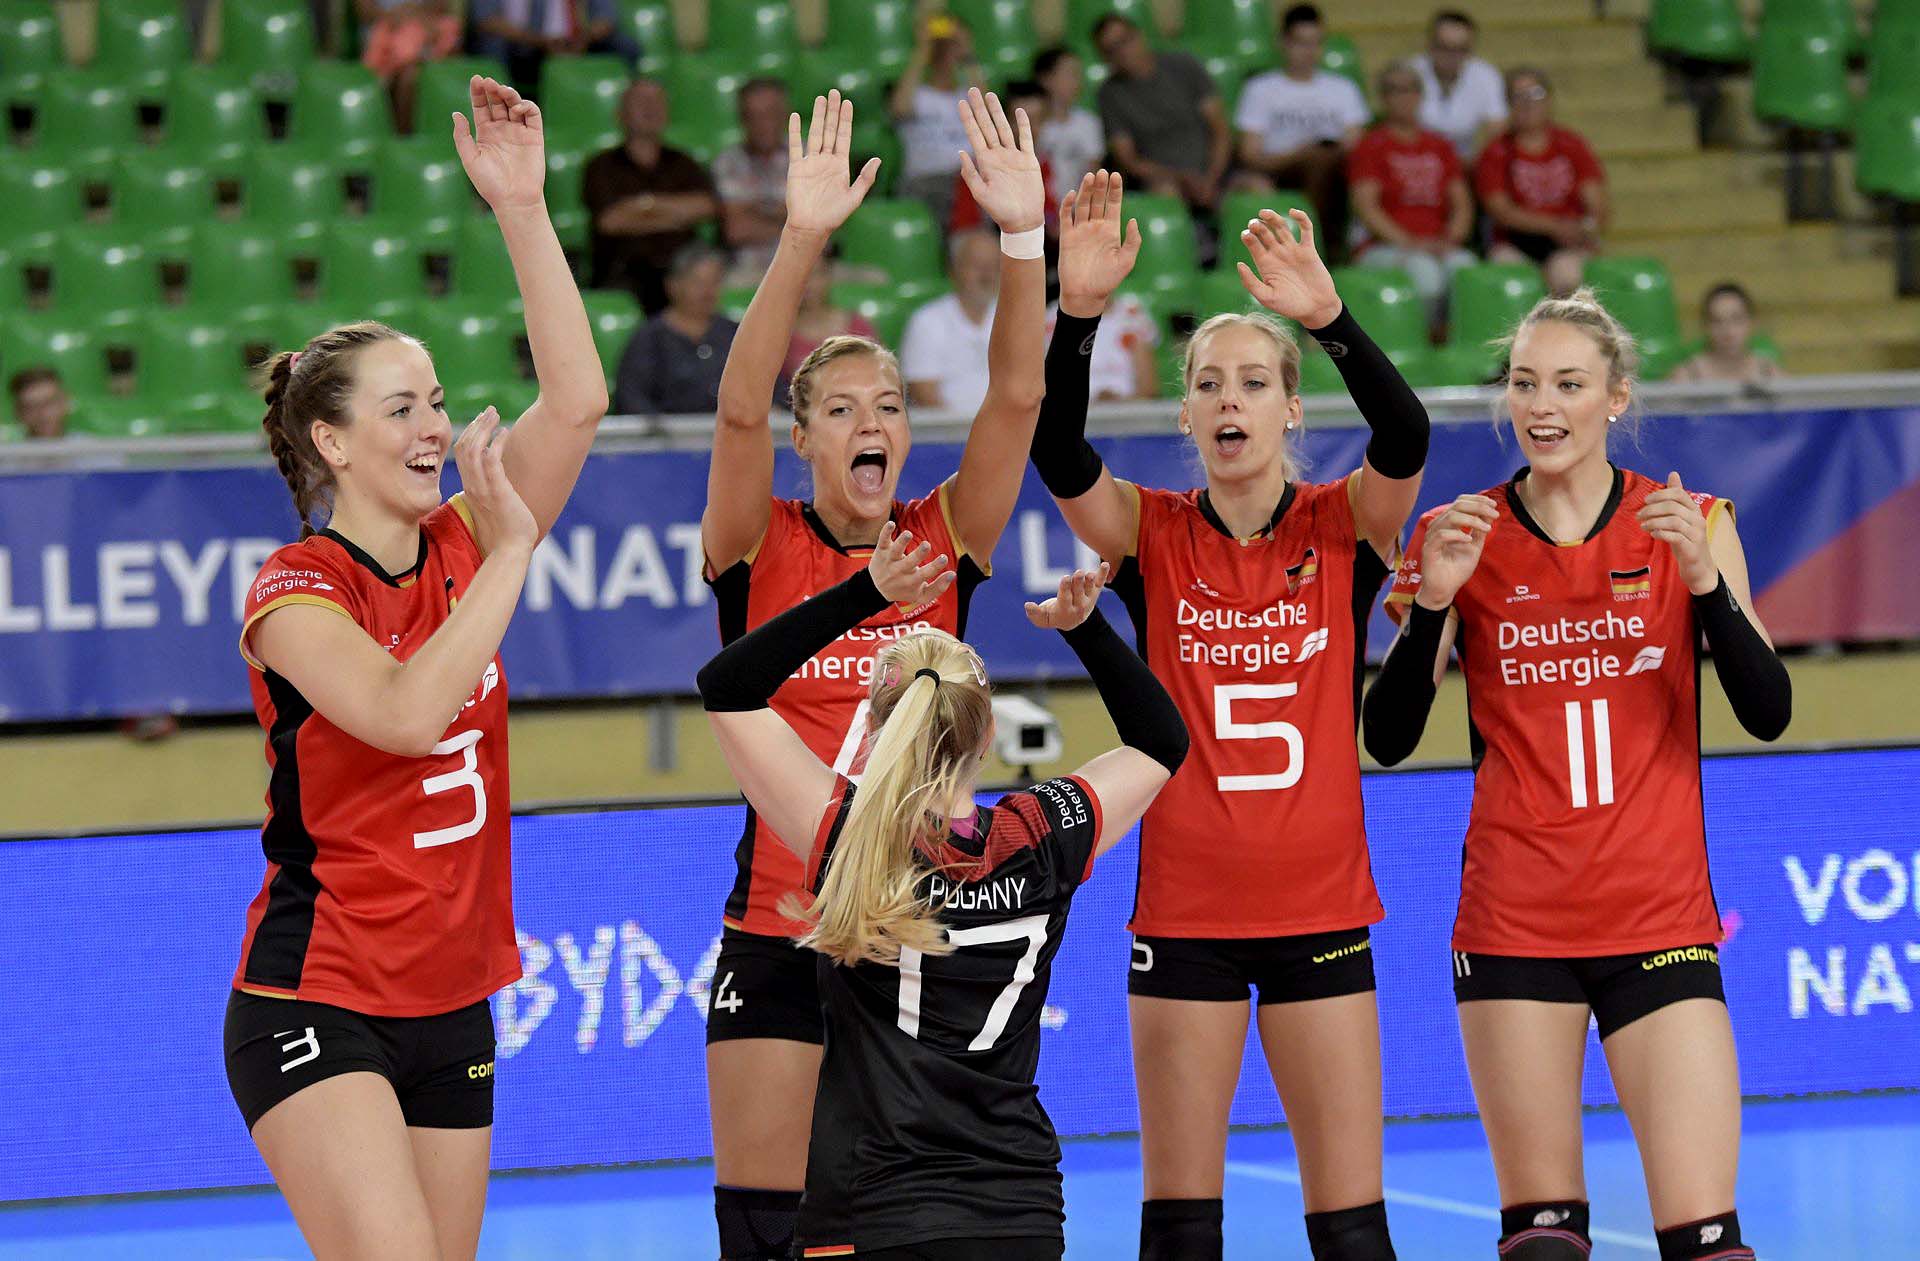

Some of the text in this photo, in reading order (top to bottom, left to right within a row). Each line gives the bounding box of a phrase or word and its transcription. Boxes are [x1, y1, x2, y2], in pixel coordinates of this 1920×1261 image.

[256, 569, 323, 591] Deutsche
[256, 577, 309, 603] Energie
[1177, 599, 1308, 631] Deutsche
[1499, 610, 1645, 650] Deutsche
[1178, 635, 1291, 673] Energie
[1500, 648, 1621, 686] Energie
[1213, 681, 1305, 792] 5
[1564, 698, 1614, 808] 11
[413, 729, 488, 849] 3
[1029, 783, 1075, 829] Deutsch
[714, 971, 743, 1013] 4
[897, 913, 1051, 1051] 17
[273, 1026, 321, 1074] 3
